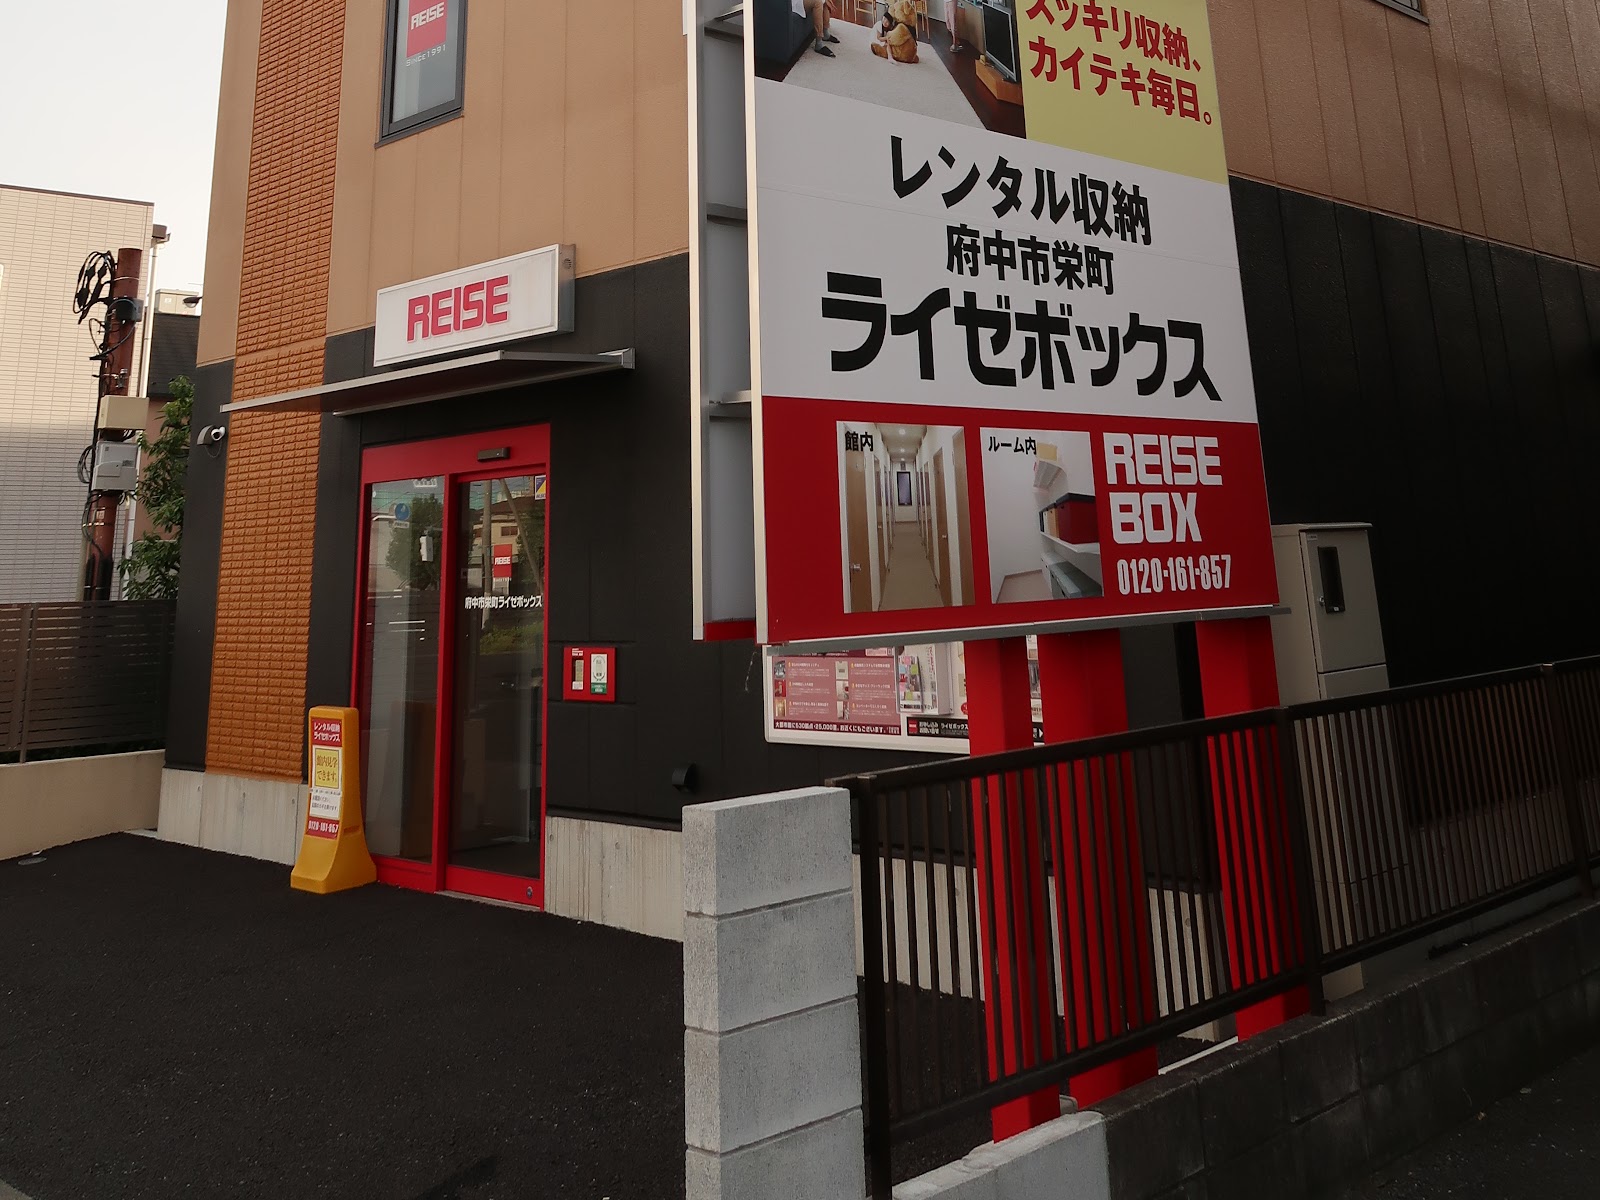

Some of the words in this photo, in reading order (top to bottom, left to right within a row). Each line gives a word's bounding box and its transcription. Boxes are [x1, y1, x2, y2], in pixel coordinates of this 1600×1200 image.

[411, 2, 445, 30] REISE
[1028, 36, 1213, 126] カイテキ毎日。
[890, 135, 1152, 246] レンタル収納
[946, 224, 1114, 295] 府中市栄町
[407, 275, 509, 342] REISE
[821, 271, 1222, 402] ライゼボックス
[844, 430, 874, 452] 館内
[988, 436, 1037, 455] ルーム内
[1102, 432, 1223, 486] REISE
[1109, 492, 1202, 544] BOX
[1117, 554, 1232, 595] 0120-161-857
